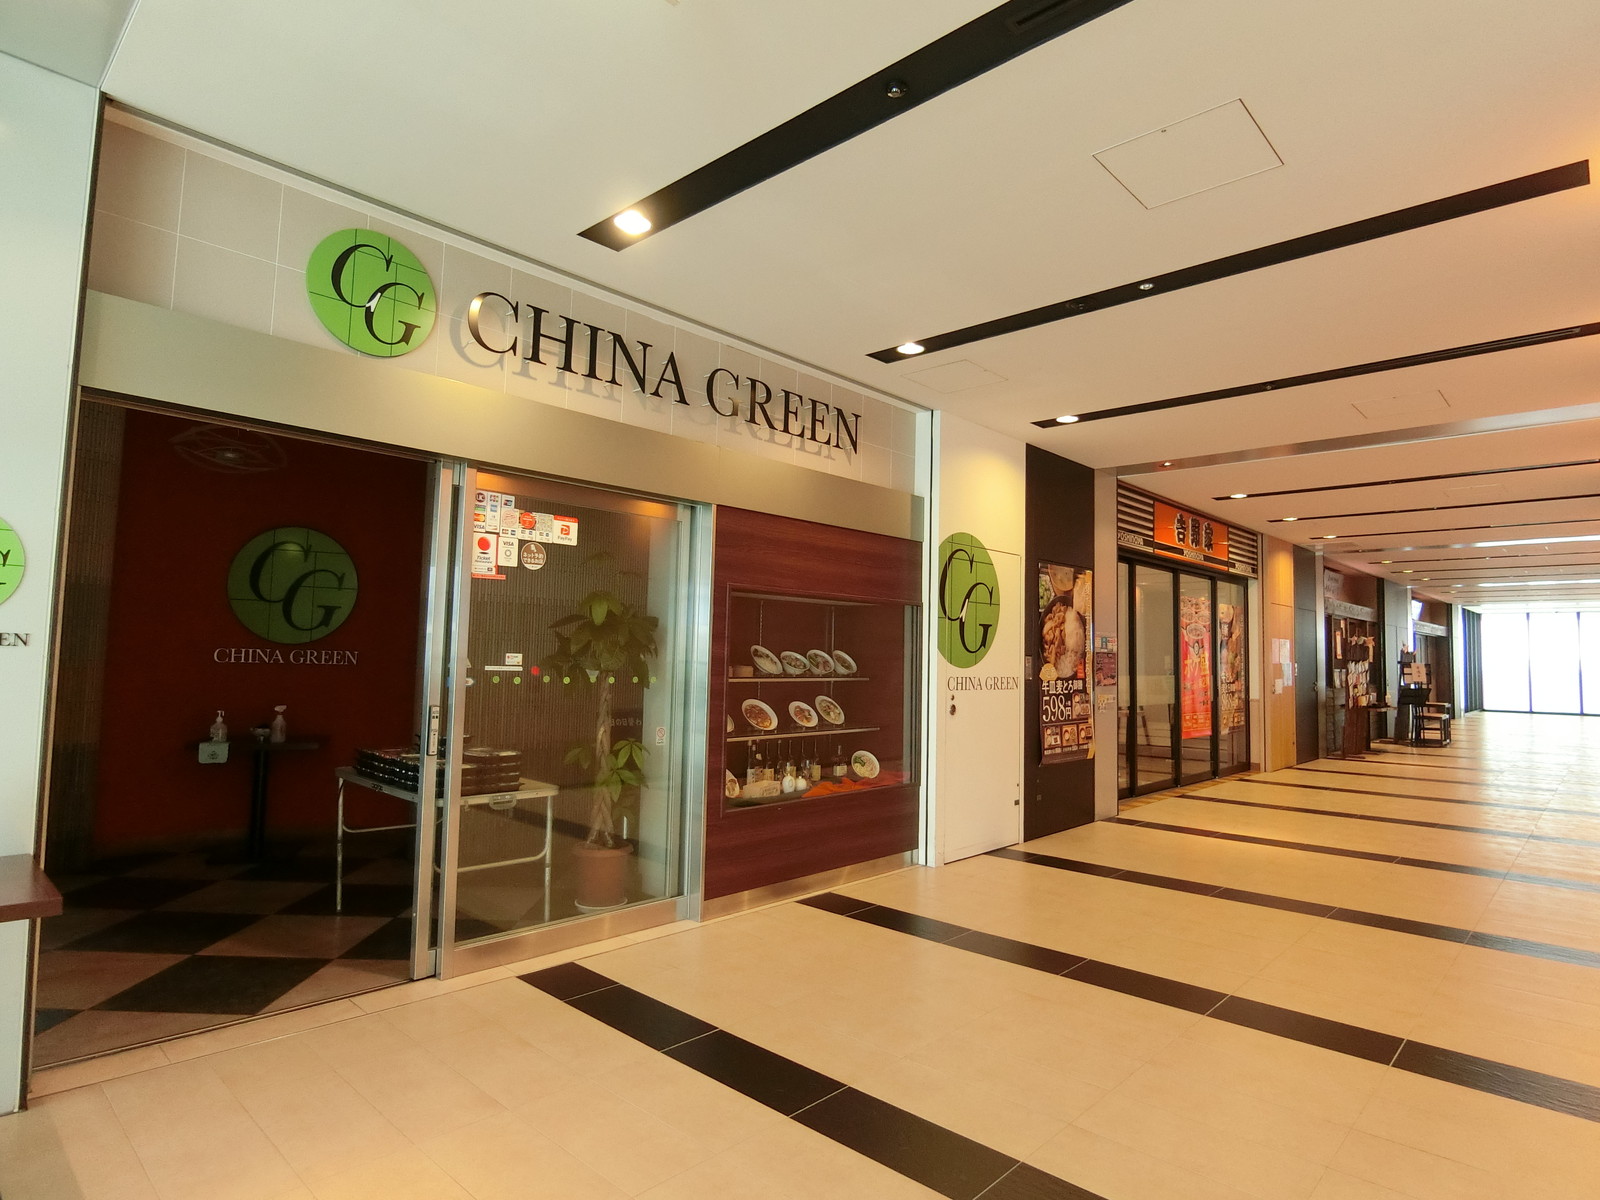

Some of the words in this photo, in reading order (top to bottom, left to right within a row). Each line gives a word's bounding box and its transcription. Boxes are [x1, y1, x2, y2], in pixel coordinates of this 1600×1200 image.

[467, 291, 690, 406] CHINA
[705, 367, 862, 456] GREEN
[1174, 511, 1214, 552] 吉野家
[213, 647, 284, 664] CHINA
[289, 649, 359, 665] GREEN
[946, 676, 982, 691] CHINA
[984, 676, 1019, 692] GREEN
